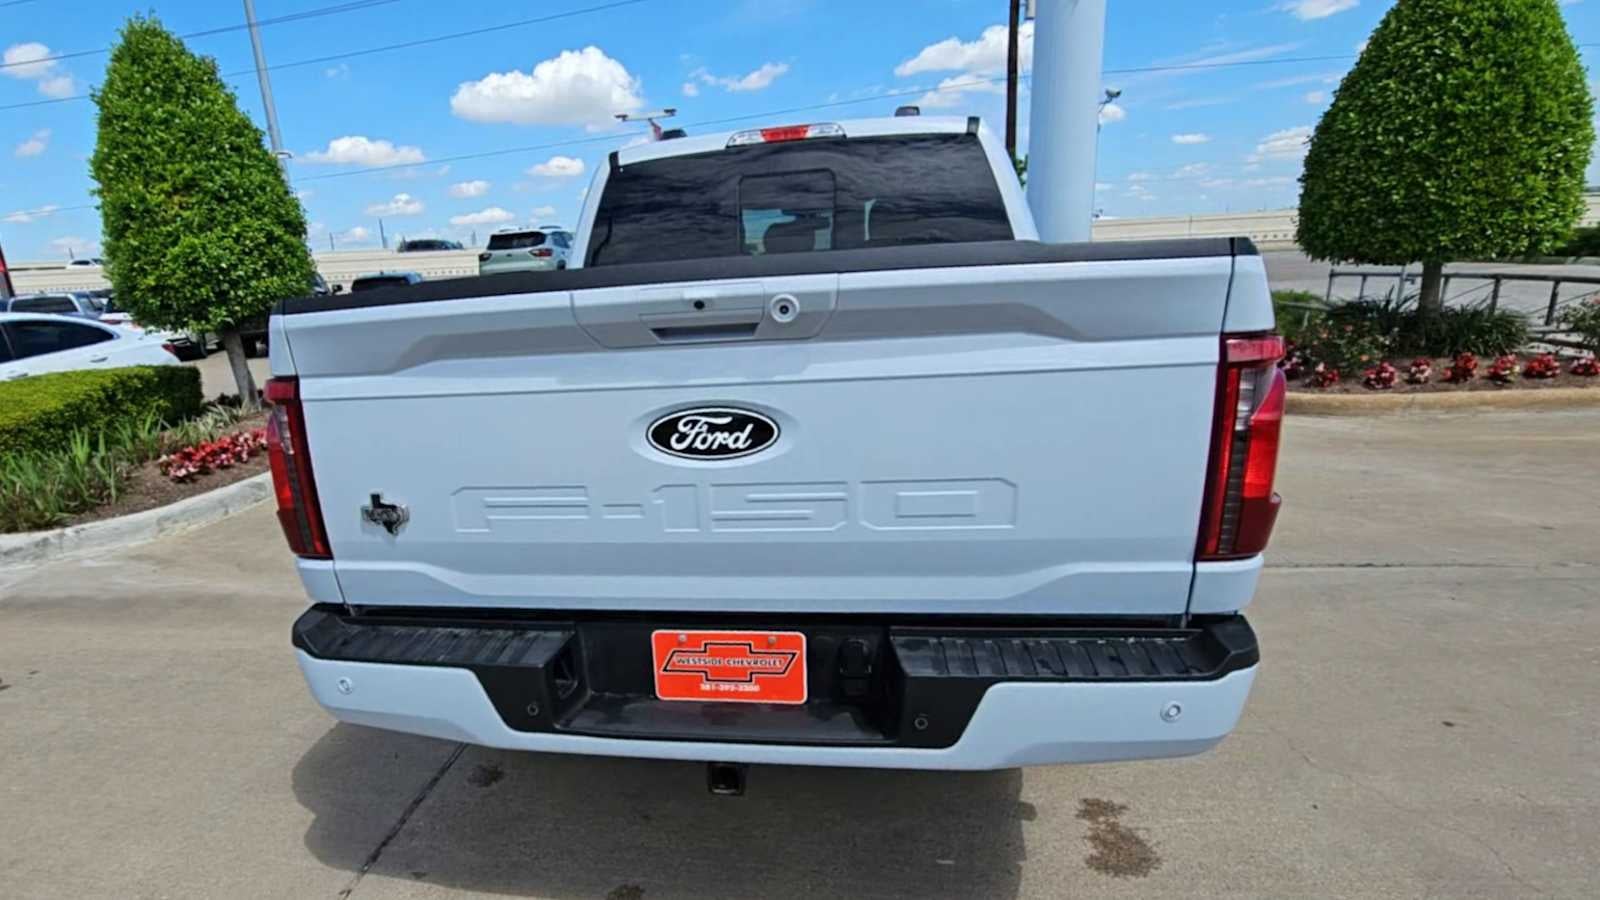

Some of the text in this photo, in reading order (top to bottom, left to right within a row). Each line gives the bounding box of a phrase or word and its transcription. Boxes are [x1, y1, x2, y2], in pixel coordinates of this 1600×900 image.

[669, 415, 755, 451] Ford
[451, 477, 1018, 533] F-150
[676, 657, 784, 668] WESTSIDE CHEVROLET
